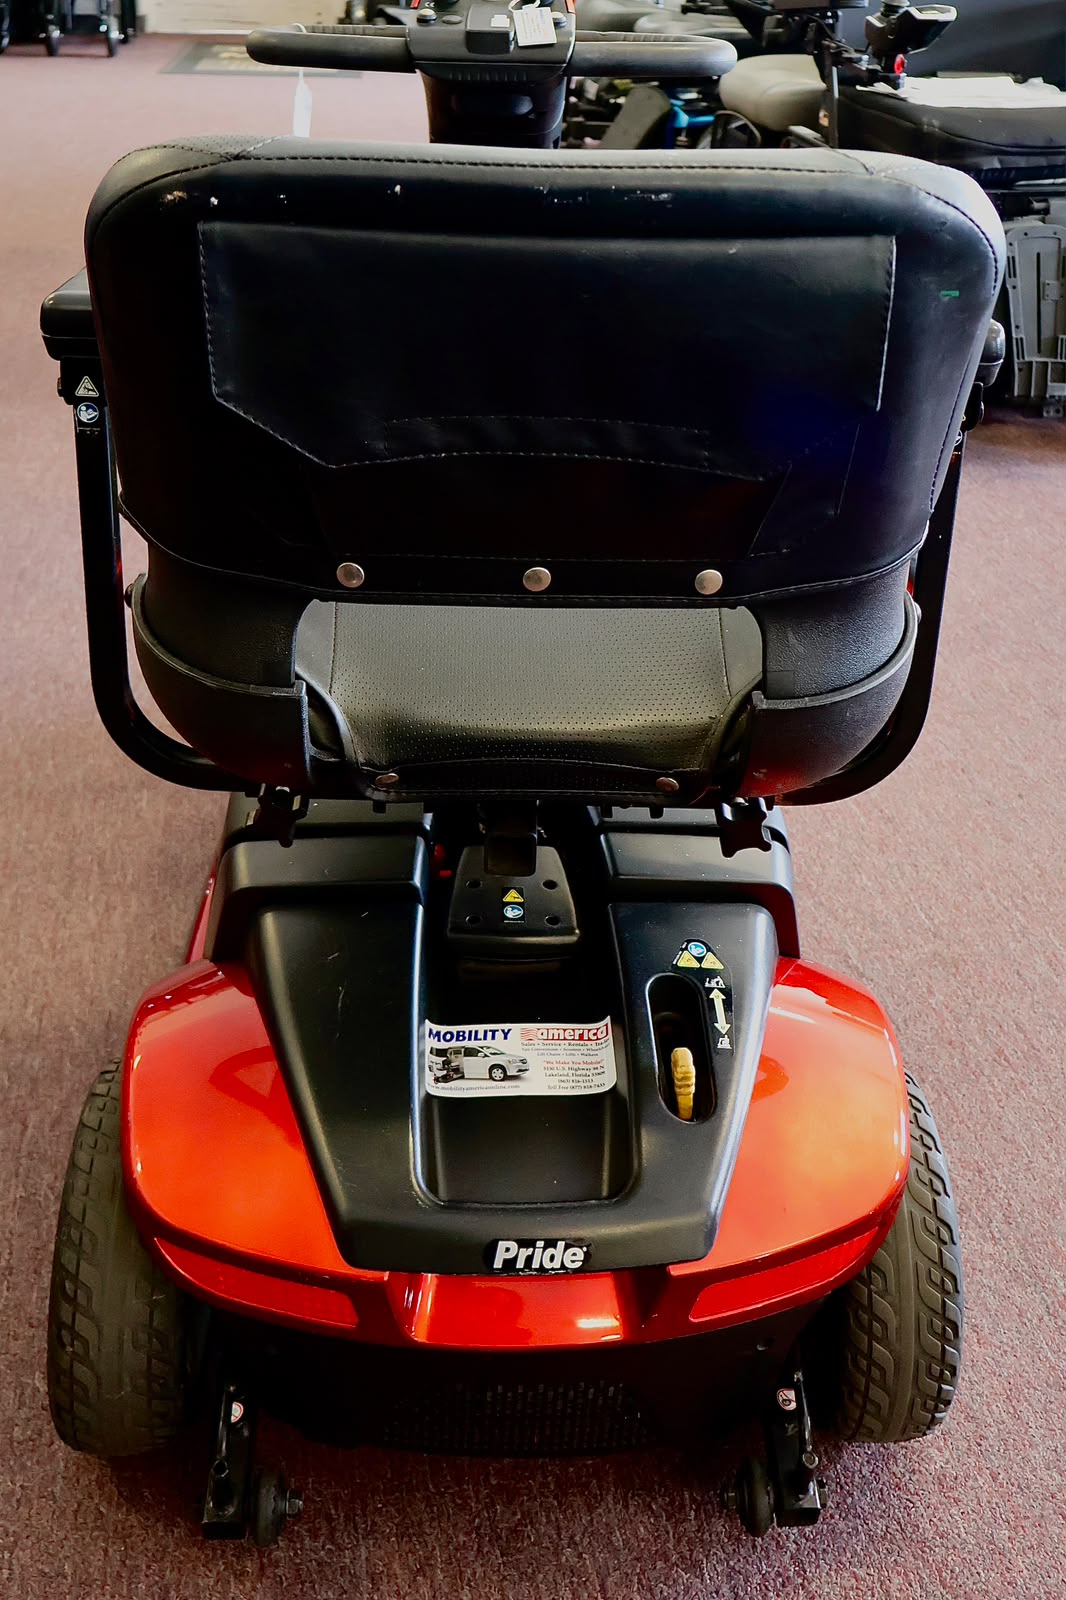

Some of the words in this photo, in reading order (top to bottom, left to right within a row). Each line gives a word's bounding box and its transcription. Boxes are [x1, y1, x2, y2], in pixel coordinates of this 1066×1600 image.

[428, 1028, 512, 1042] MOBILITY
[537, 1025, 608, 1040] america
[493, 1241, 585, 1269] Pride
